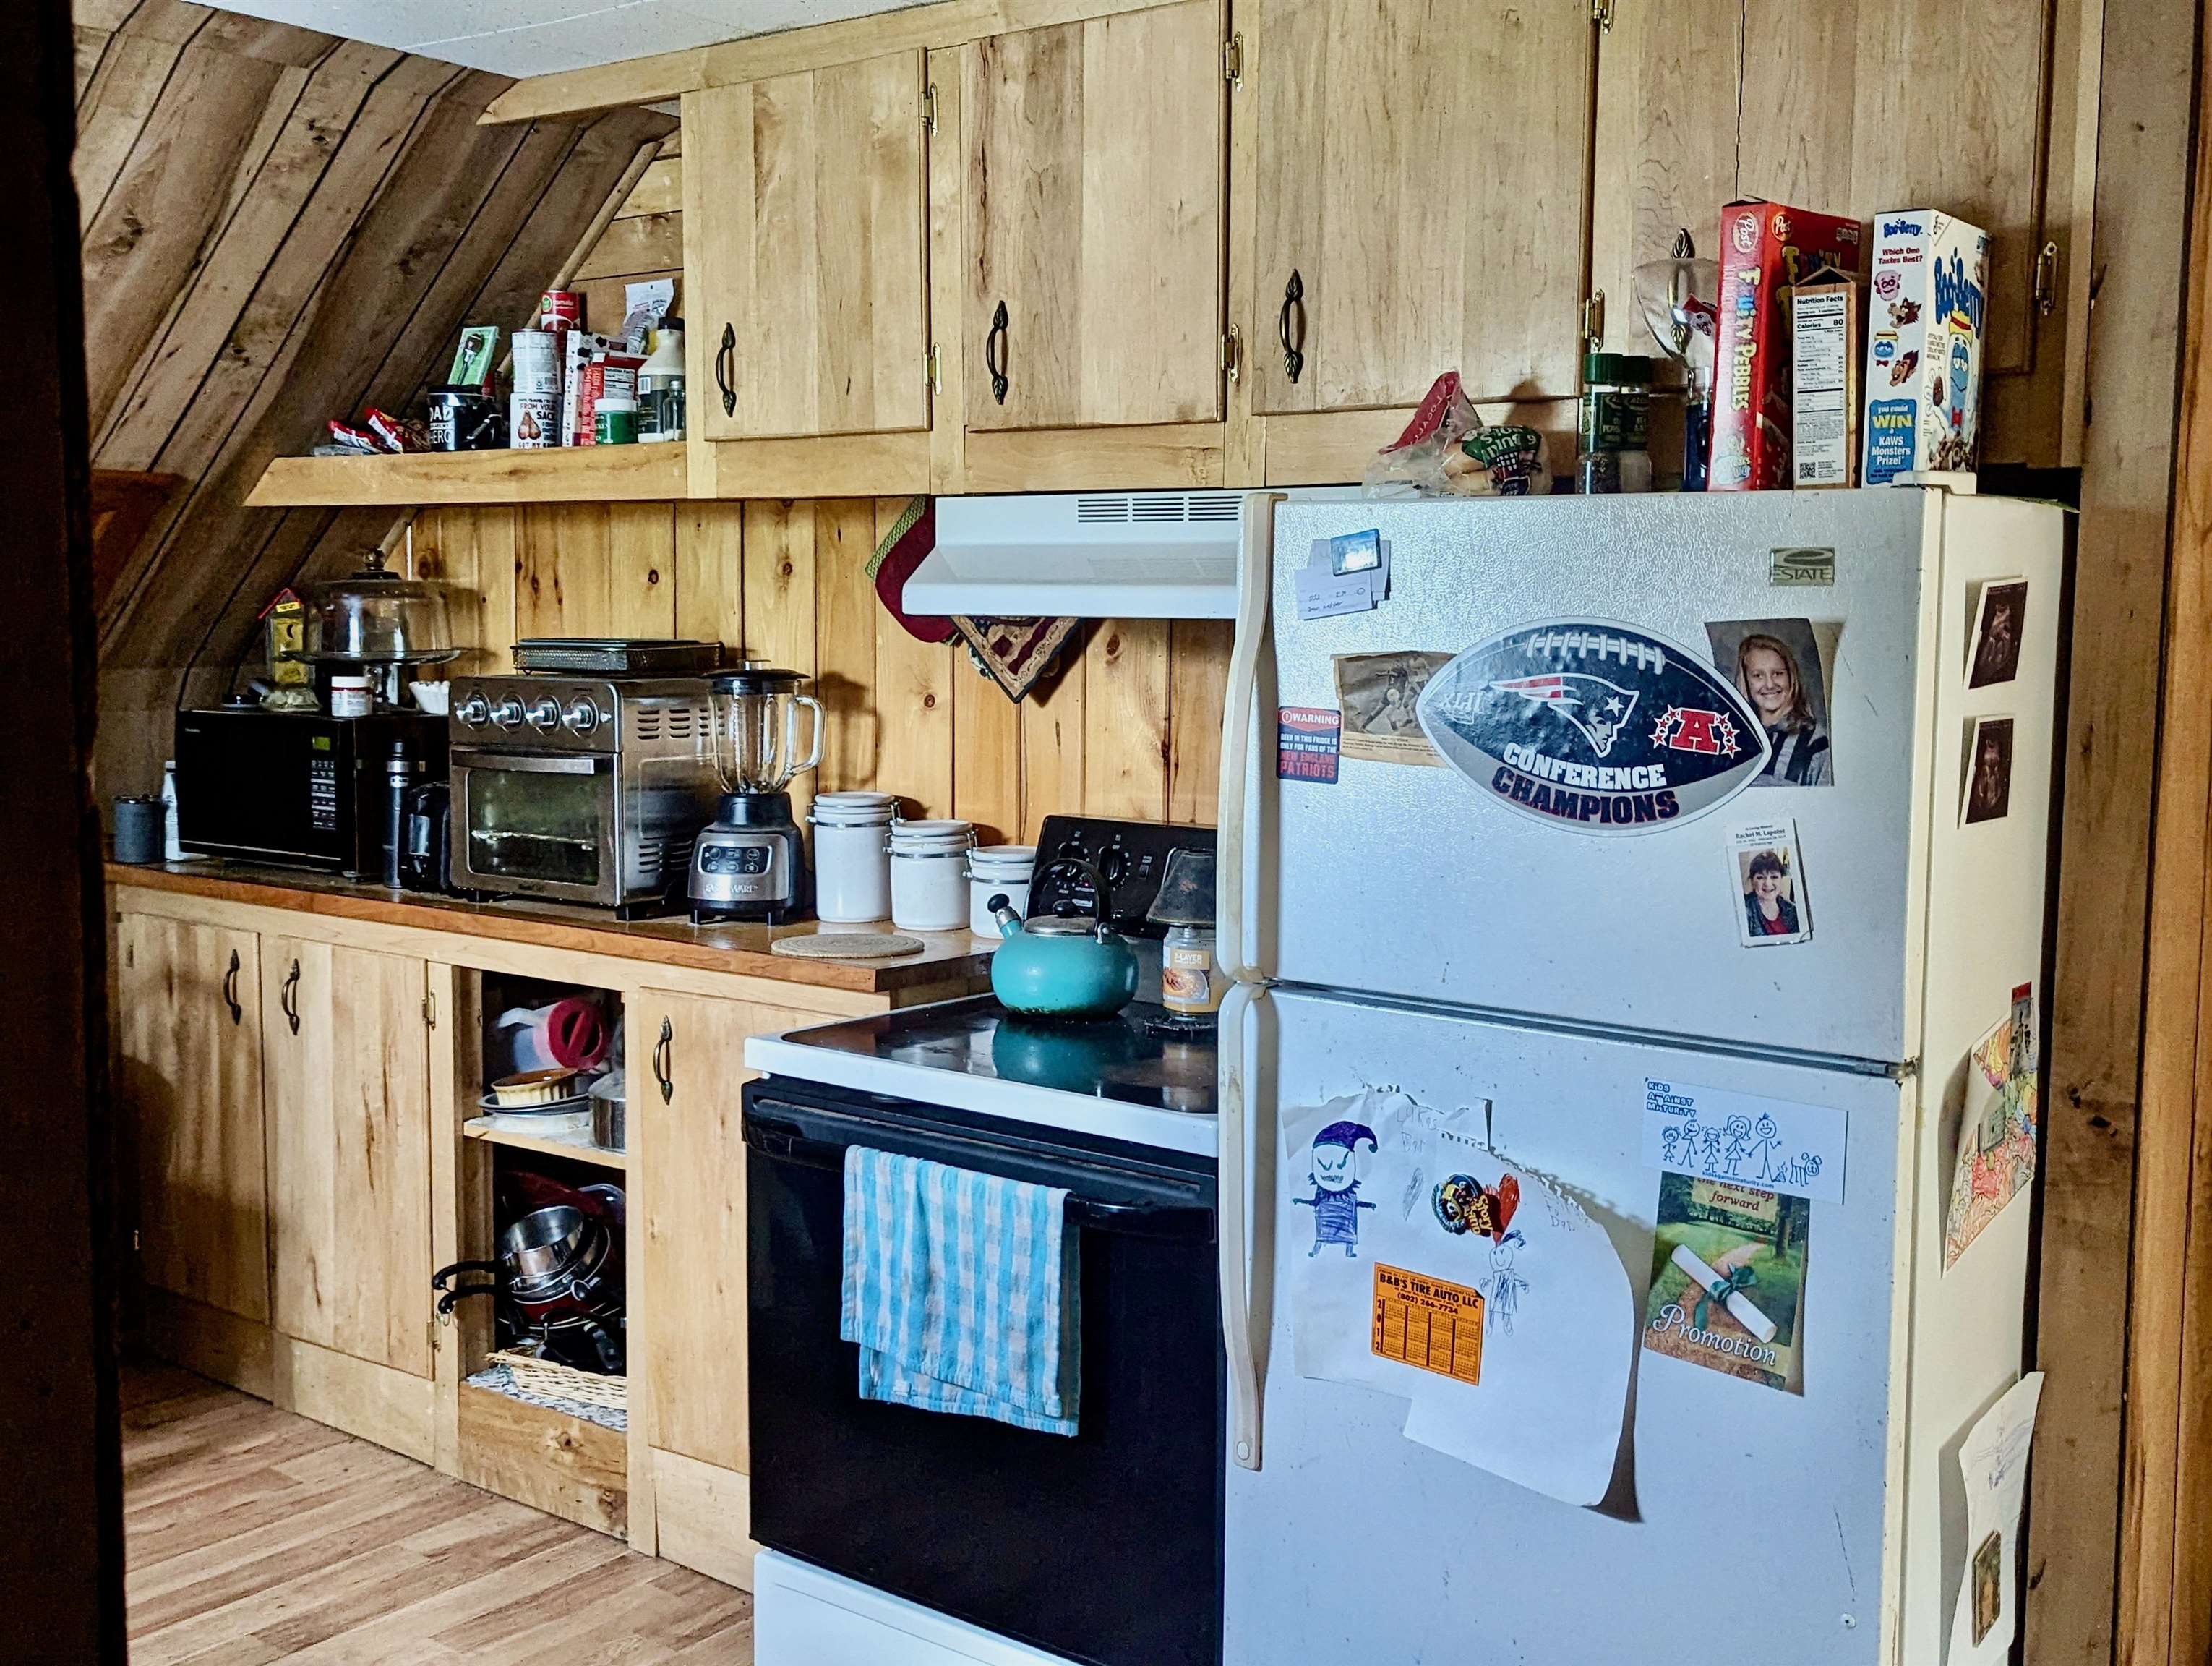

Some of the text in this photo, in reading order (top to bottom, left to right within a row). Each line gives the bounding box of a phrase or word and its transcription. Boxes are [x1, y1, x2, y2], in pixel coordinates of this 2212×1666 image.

[1738, 218, 1754, 247] Post
[1775, 216, 1791, 234] Post
[1872, 414, 1912, 428] WIN
[1879, 436, 1904, 446] KAWS
[1872, 446, 1911, 456] Monsters
[1772, 568, 1833, 581] ESTATE
[1293, 713, 1339, 725] WARNING
[1280, 761, 1335, 778] PATRIOTS
[1503, 742, 1667, 790] CONFERENCE
[1491, 766, 1680, 824] CHAMPIONS
[1709, 1190, 1759, 1211] forward
[1749, 1187, 1775, 1202] step
[1478, 1195, 1493, 1231] Story
[1379, 1272, 1407, 1289] B&B'S
[1410, 1281, 1431, 1296] TIRE
[1433, 1287, 1459, 1303] AUTO
[1461, 1295, 1478, 1308] LLC
[1397, 1291, 1418, 1304] (802)
[1652, 1304, 1776, 1366] Promotion
